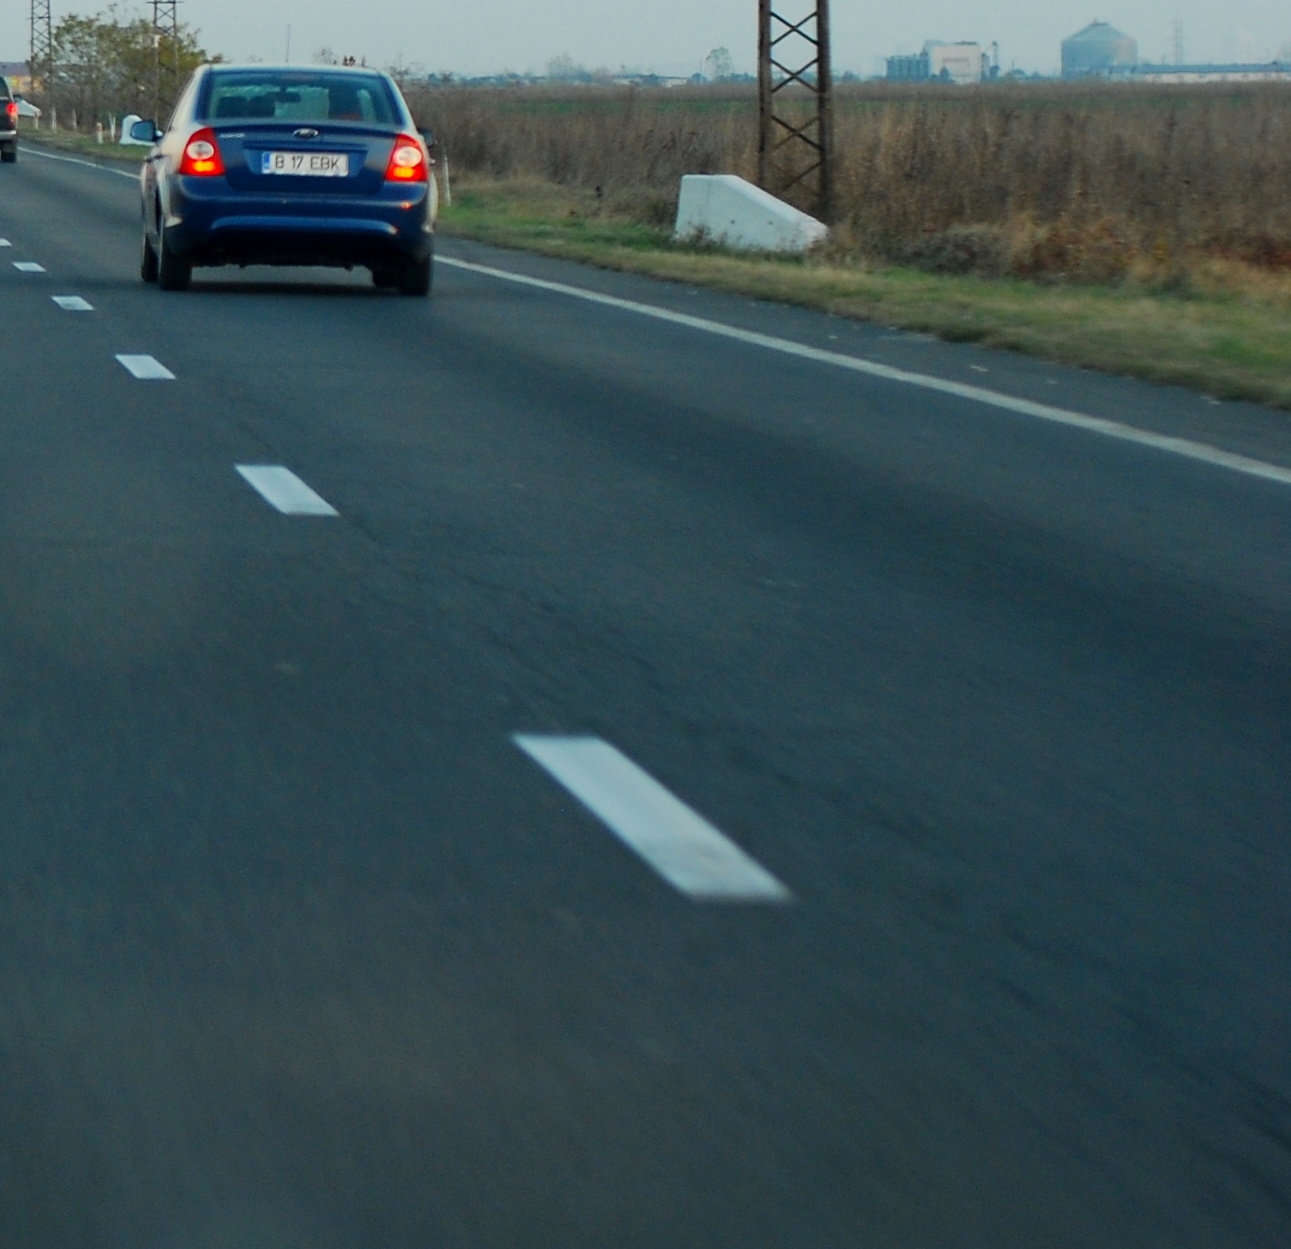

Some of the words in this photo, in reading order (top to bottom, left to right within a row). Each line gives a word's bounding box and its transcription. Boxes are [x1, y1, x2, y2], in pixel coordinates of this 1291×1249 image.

[275, 155, 285, 169] B
[291, 155, 304, 170] 17
[310, 156, 340, 171] EBK
